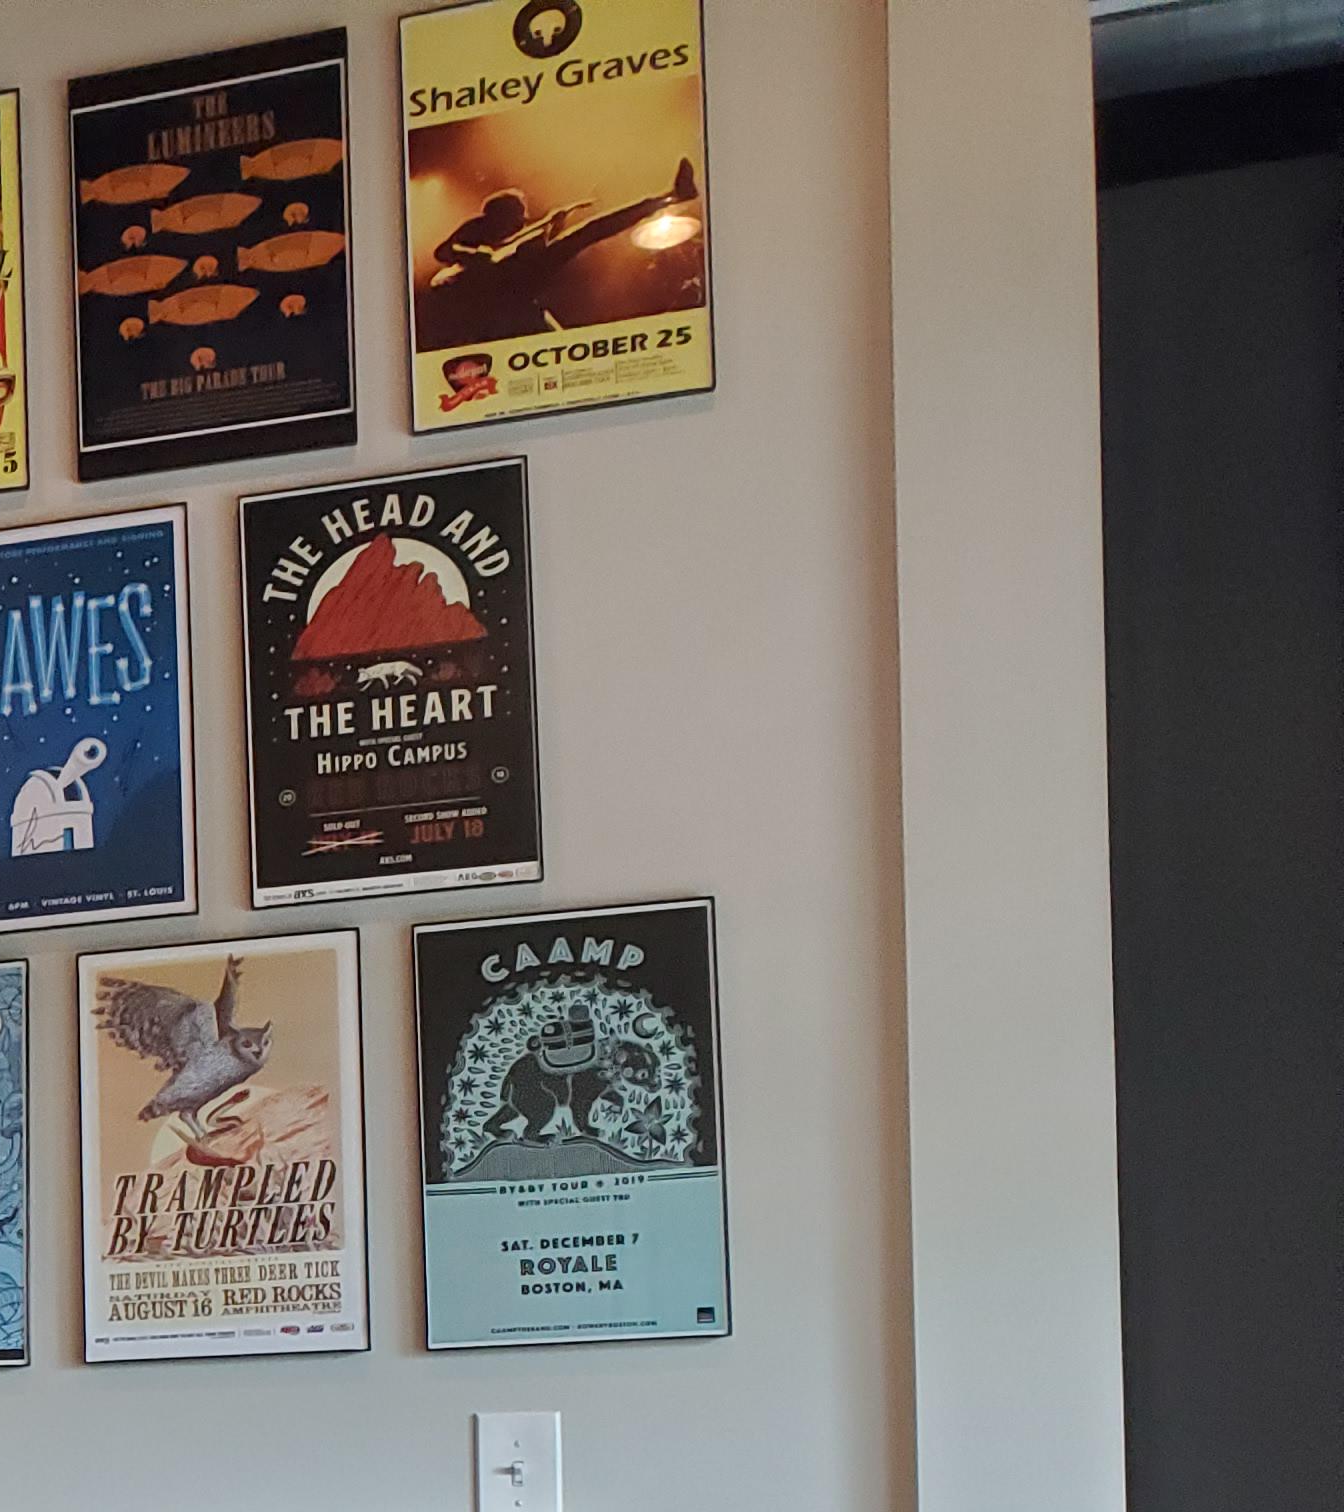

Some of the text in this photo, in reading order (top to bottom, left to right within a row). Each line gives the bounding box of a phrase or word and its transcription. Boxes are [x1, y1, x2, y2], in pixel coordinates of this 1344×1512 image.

[409, 44, 689, 117] Shakey Graves
[508, 332, 648, 371] OCTOBER
[655, 325, 692, 349] 25
[250, 361, 286, 384] TOUR
[3, 451, 19, 474] 5
[262, 493, 511, 606] THE HEAD AND
[284, 685, 498, 741] THE HEART
[317, 742, 468, 775] HIPPO CAMPUS
[410, 822, 454, 844] JULY
[143, 886, 174, 897] LOUIS
[481, 936, 645, 983] CAAMP
[112, 1159, 337, 1217] TRAMPLED
[552, 1181, 589, 1192] TOUR
[614, 1175, 645, 1186] 2019
[107, 1202, 336, 1256] BY TURTLES
[502, 1233, 640, 1252] SAT. DECEMBER 7
[258, 1260, 341, 1281] DEER TICK
[519, 1254, 618, 1277] ROYALE
[109, 1265, 251, 1291] THE DEVIL MAKES THREE
[521, 1280, 625, 1296] BOSTON, MA
[109, 1289, 211, 1302] SATURDAY
[222, 1282, 342, 1306] RED ROCKS
[108, 1298, 213, 1322] AUGUST 16
[220, 1301, 342, 1316] AMPHITHEATRE
